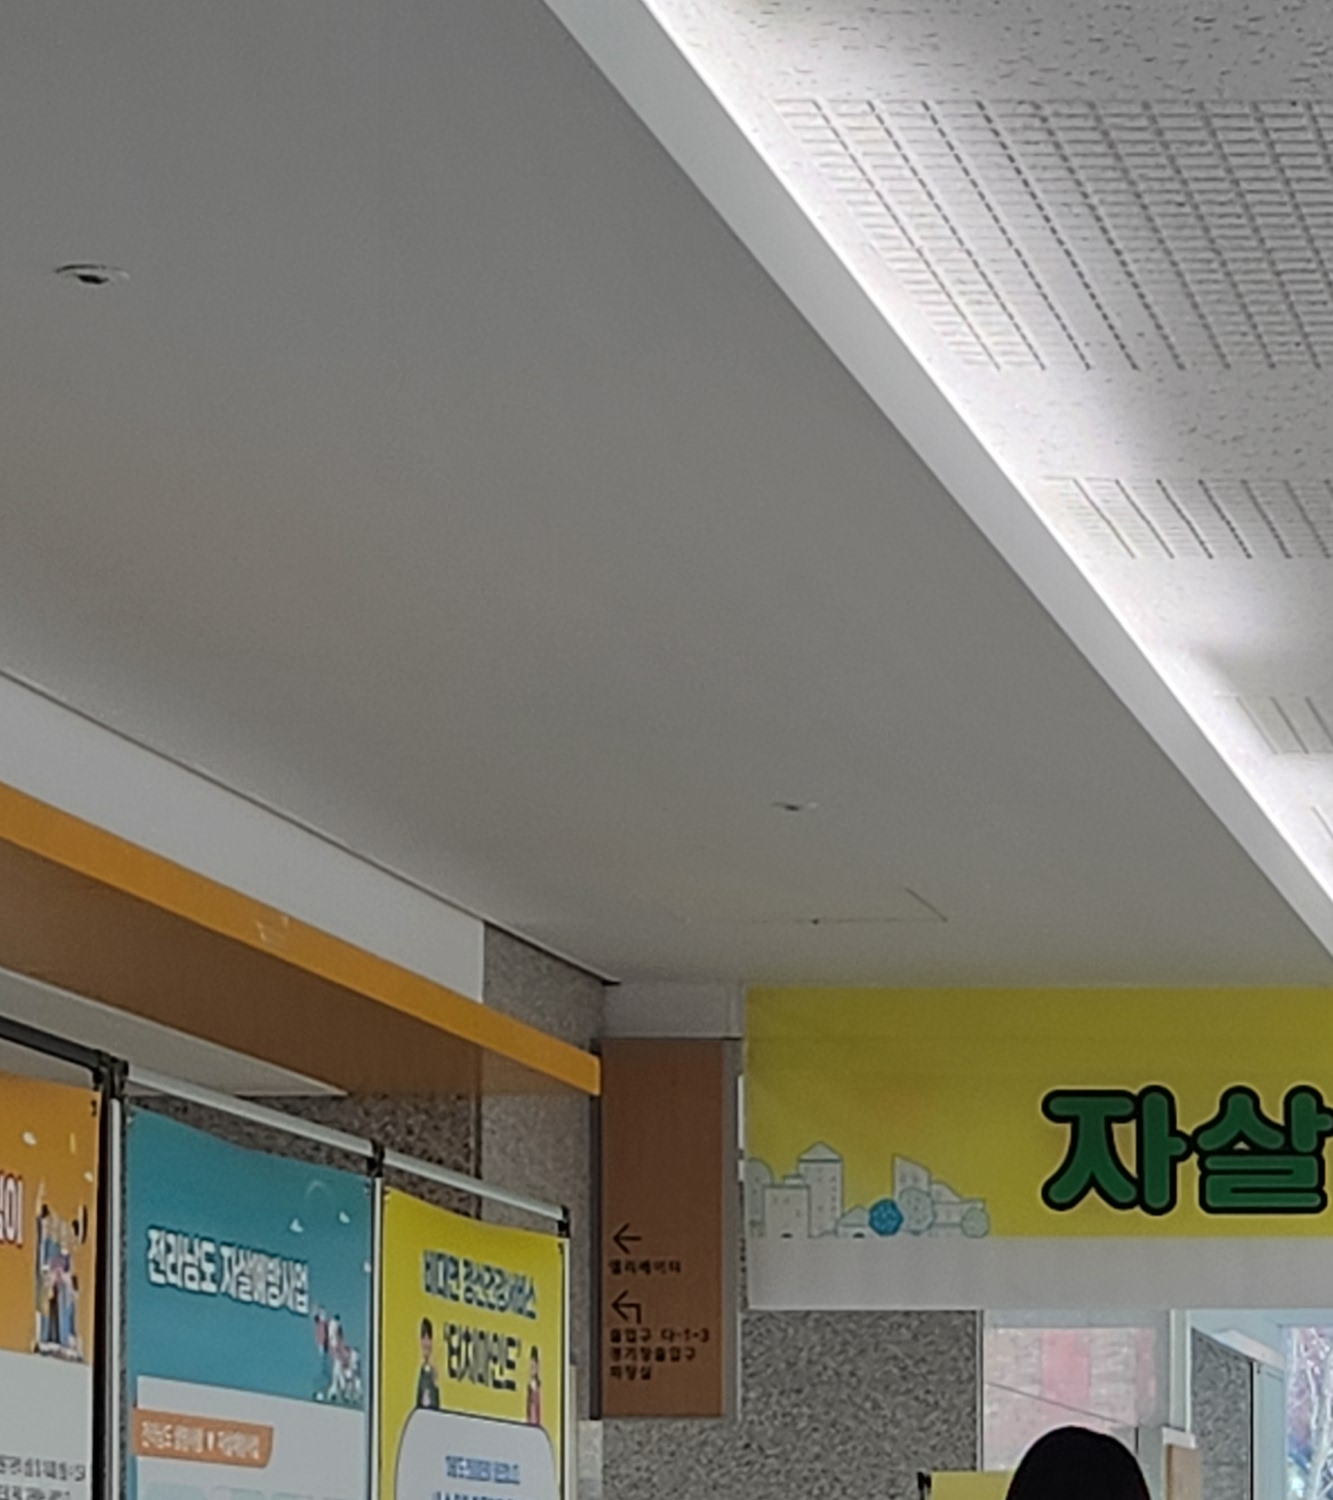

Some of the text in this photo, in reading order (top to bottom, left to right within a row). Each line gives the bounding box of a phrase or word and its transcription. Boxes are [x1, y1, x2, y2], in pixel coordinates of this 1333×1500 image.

[147, 1225, 310, 1317] 전라남도 자살예방사업
[609, 1328, 652, 1343] 출입구
[609, 1365, 653, 1380] 화장실
